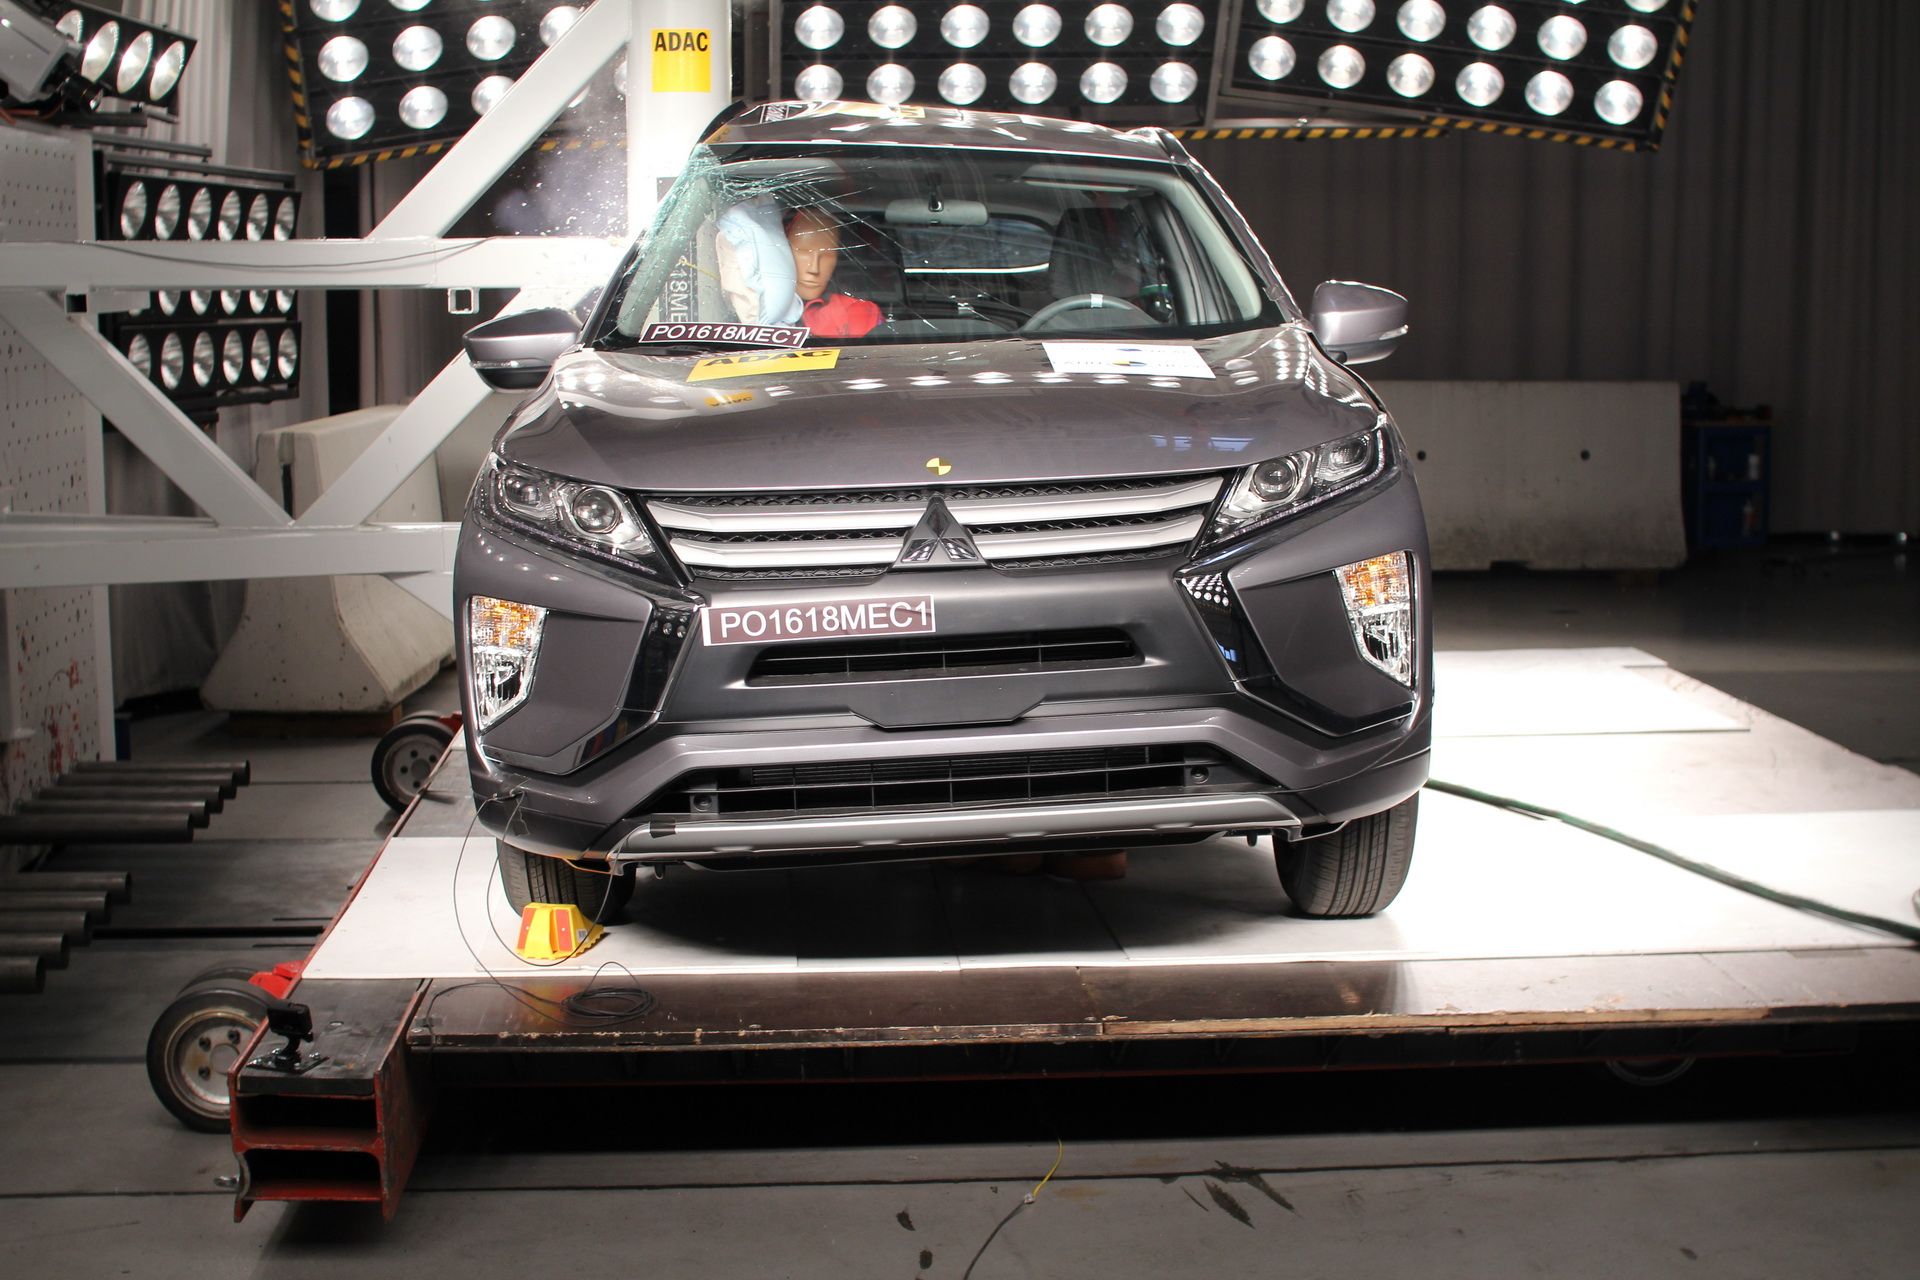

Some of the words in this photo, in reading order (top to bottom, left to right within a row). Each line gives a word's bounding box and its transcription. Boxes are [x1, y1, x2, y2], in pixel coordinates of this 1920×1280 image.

[654, 32, 708, 52] ADAC
[670, 254, 688, 324] 18ME
[650, 324, 803, 345] PO1618MEC1
[703, 350, 833, 367] ADAC
[720, 600, 928, 638] PO1618MEC1
